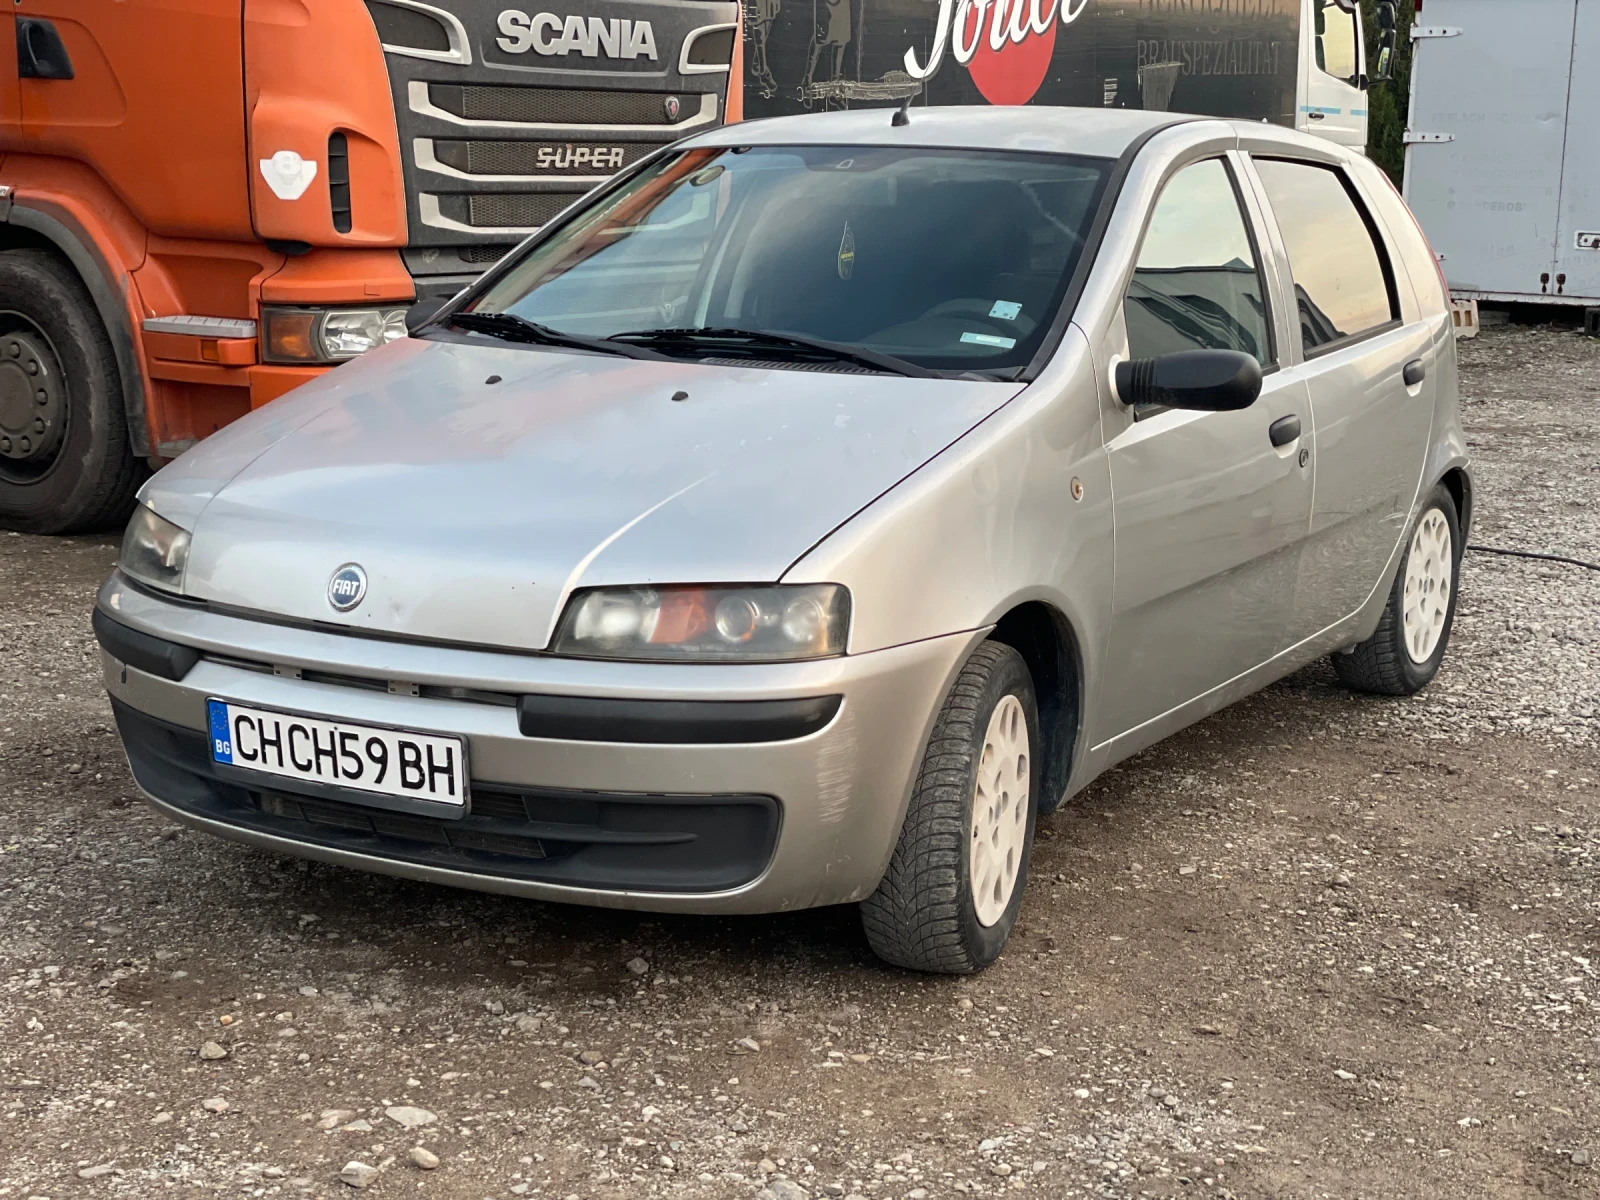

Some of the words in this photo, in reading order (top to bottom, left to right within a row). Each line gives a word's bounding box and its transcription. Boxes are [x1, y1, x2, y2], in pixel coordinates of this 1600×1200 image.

[496, 9, 658, 60] SCANIA
[535, 146, 624, 168] SUPER
[332, 579, 360, 596] FIAT
[215, 739, 231, 755] BG
